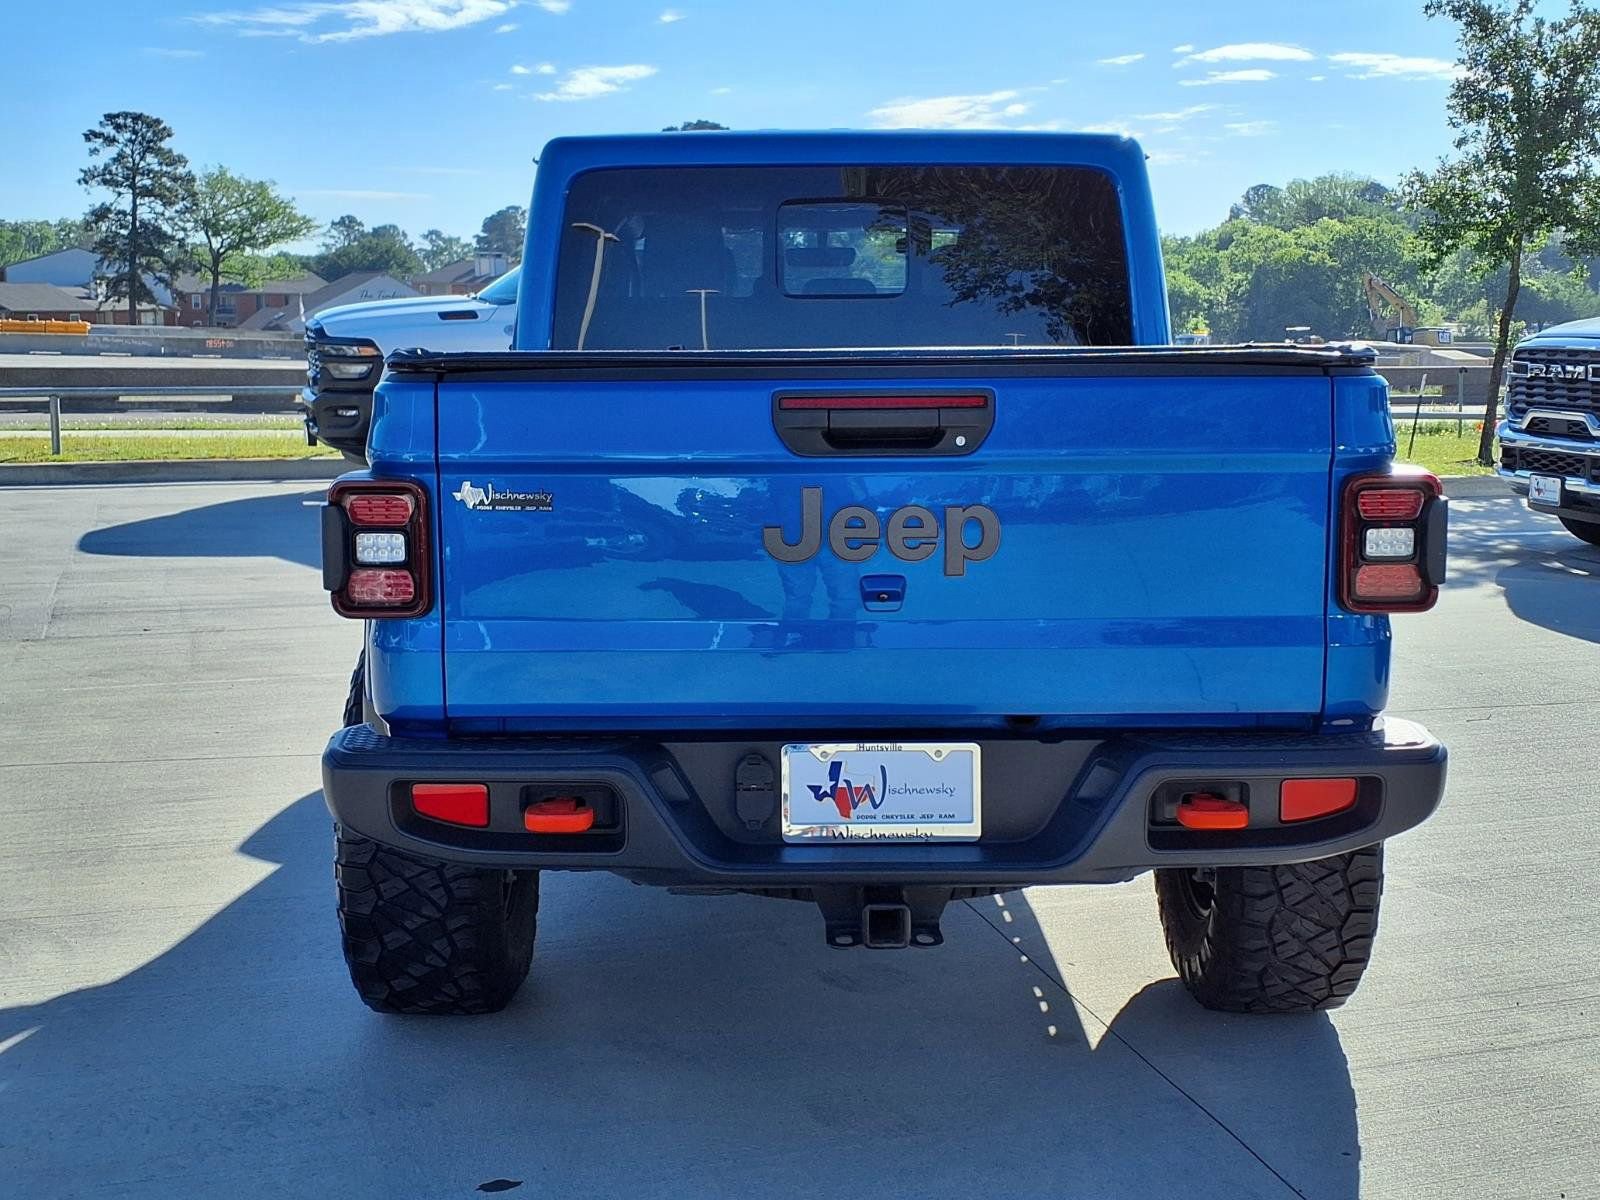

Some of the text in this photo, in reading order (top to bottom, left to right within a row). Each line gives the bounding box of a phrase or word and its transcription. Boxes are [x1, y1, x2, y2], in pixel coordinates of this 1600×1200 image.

[1528, 363, 1586, 379] RAM
[468, 483, 553, 505] Wischnewsky
[763, 487, 1001, 577] Jeep
[857, 743, 903, 752] Huntsville
[843, 764, 956, 810] Wischnewsky
[832, 825, 933, 841] Wischnewsky
